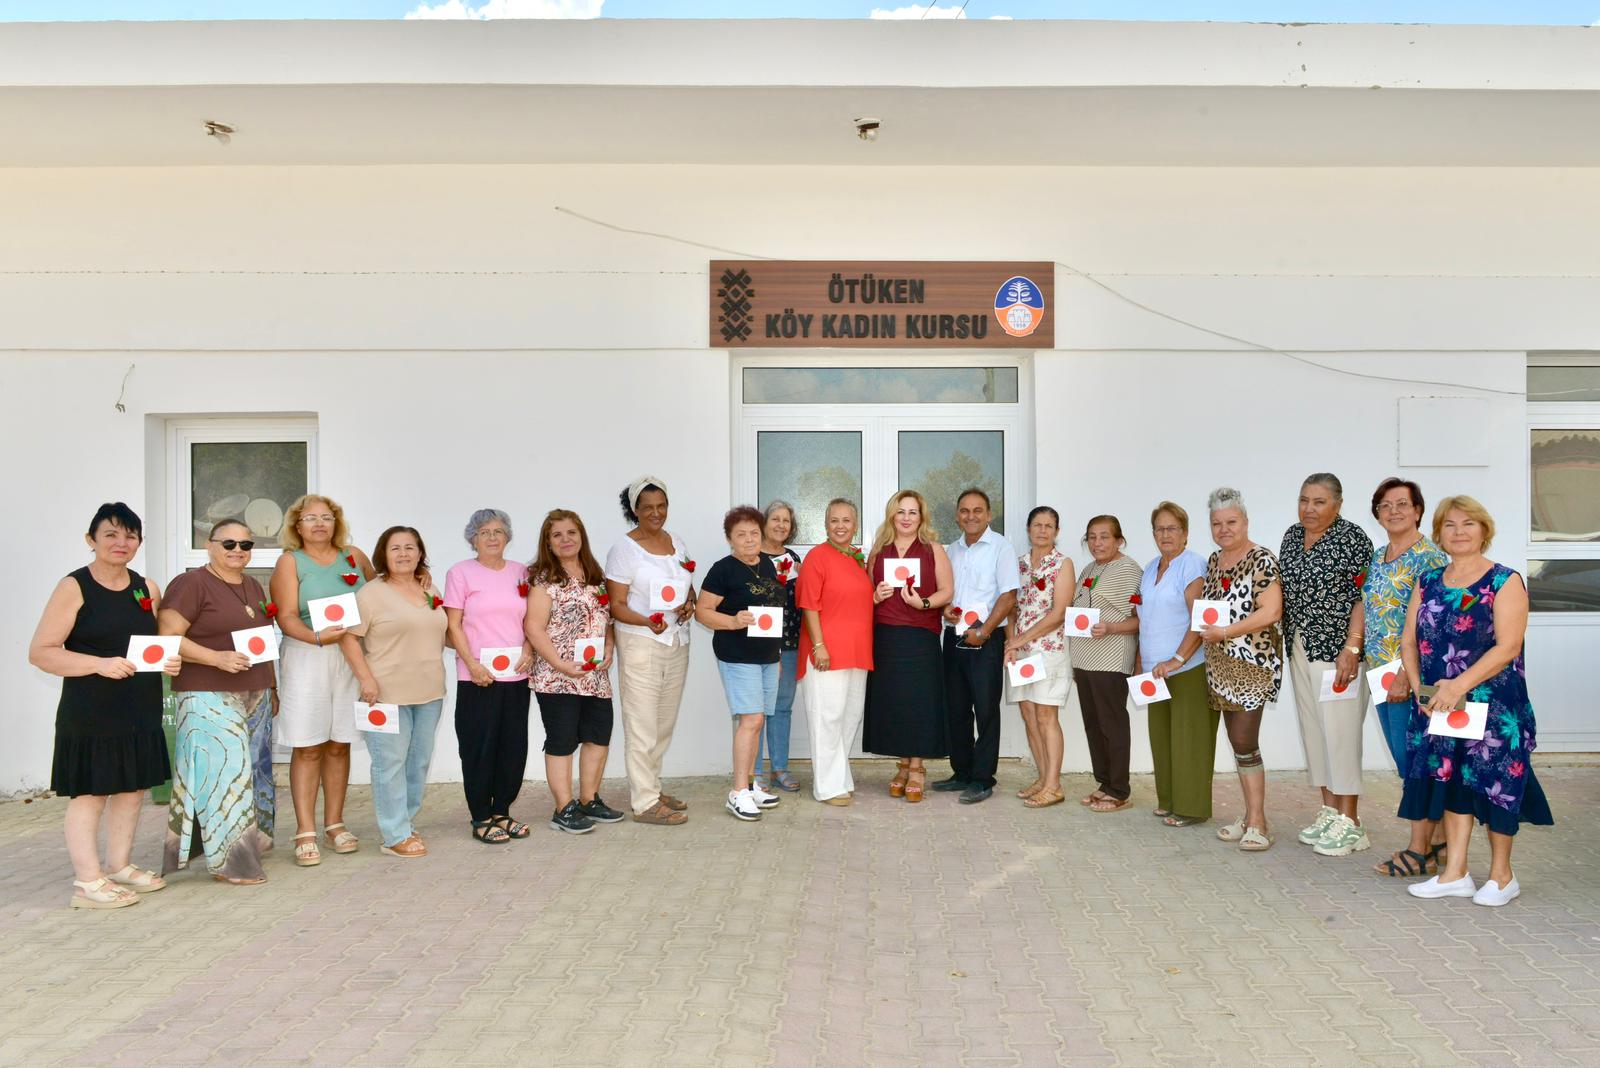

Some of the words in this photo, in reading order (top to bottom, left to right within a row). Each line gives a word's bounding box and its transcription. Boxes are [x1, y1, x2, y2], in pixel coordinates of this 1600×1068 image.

[828, 273, 925, 304] ÖTÜKEN
[765, 308, 813, 339] KÖY
[822, 314, 896, 339] KADIN
[906, 314, 987, 340] KURSU
